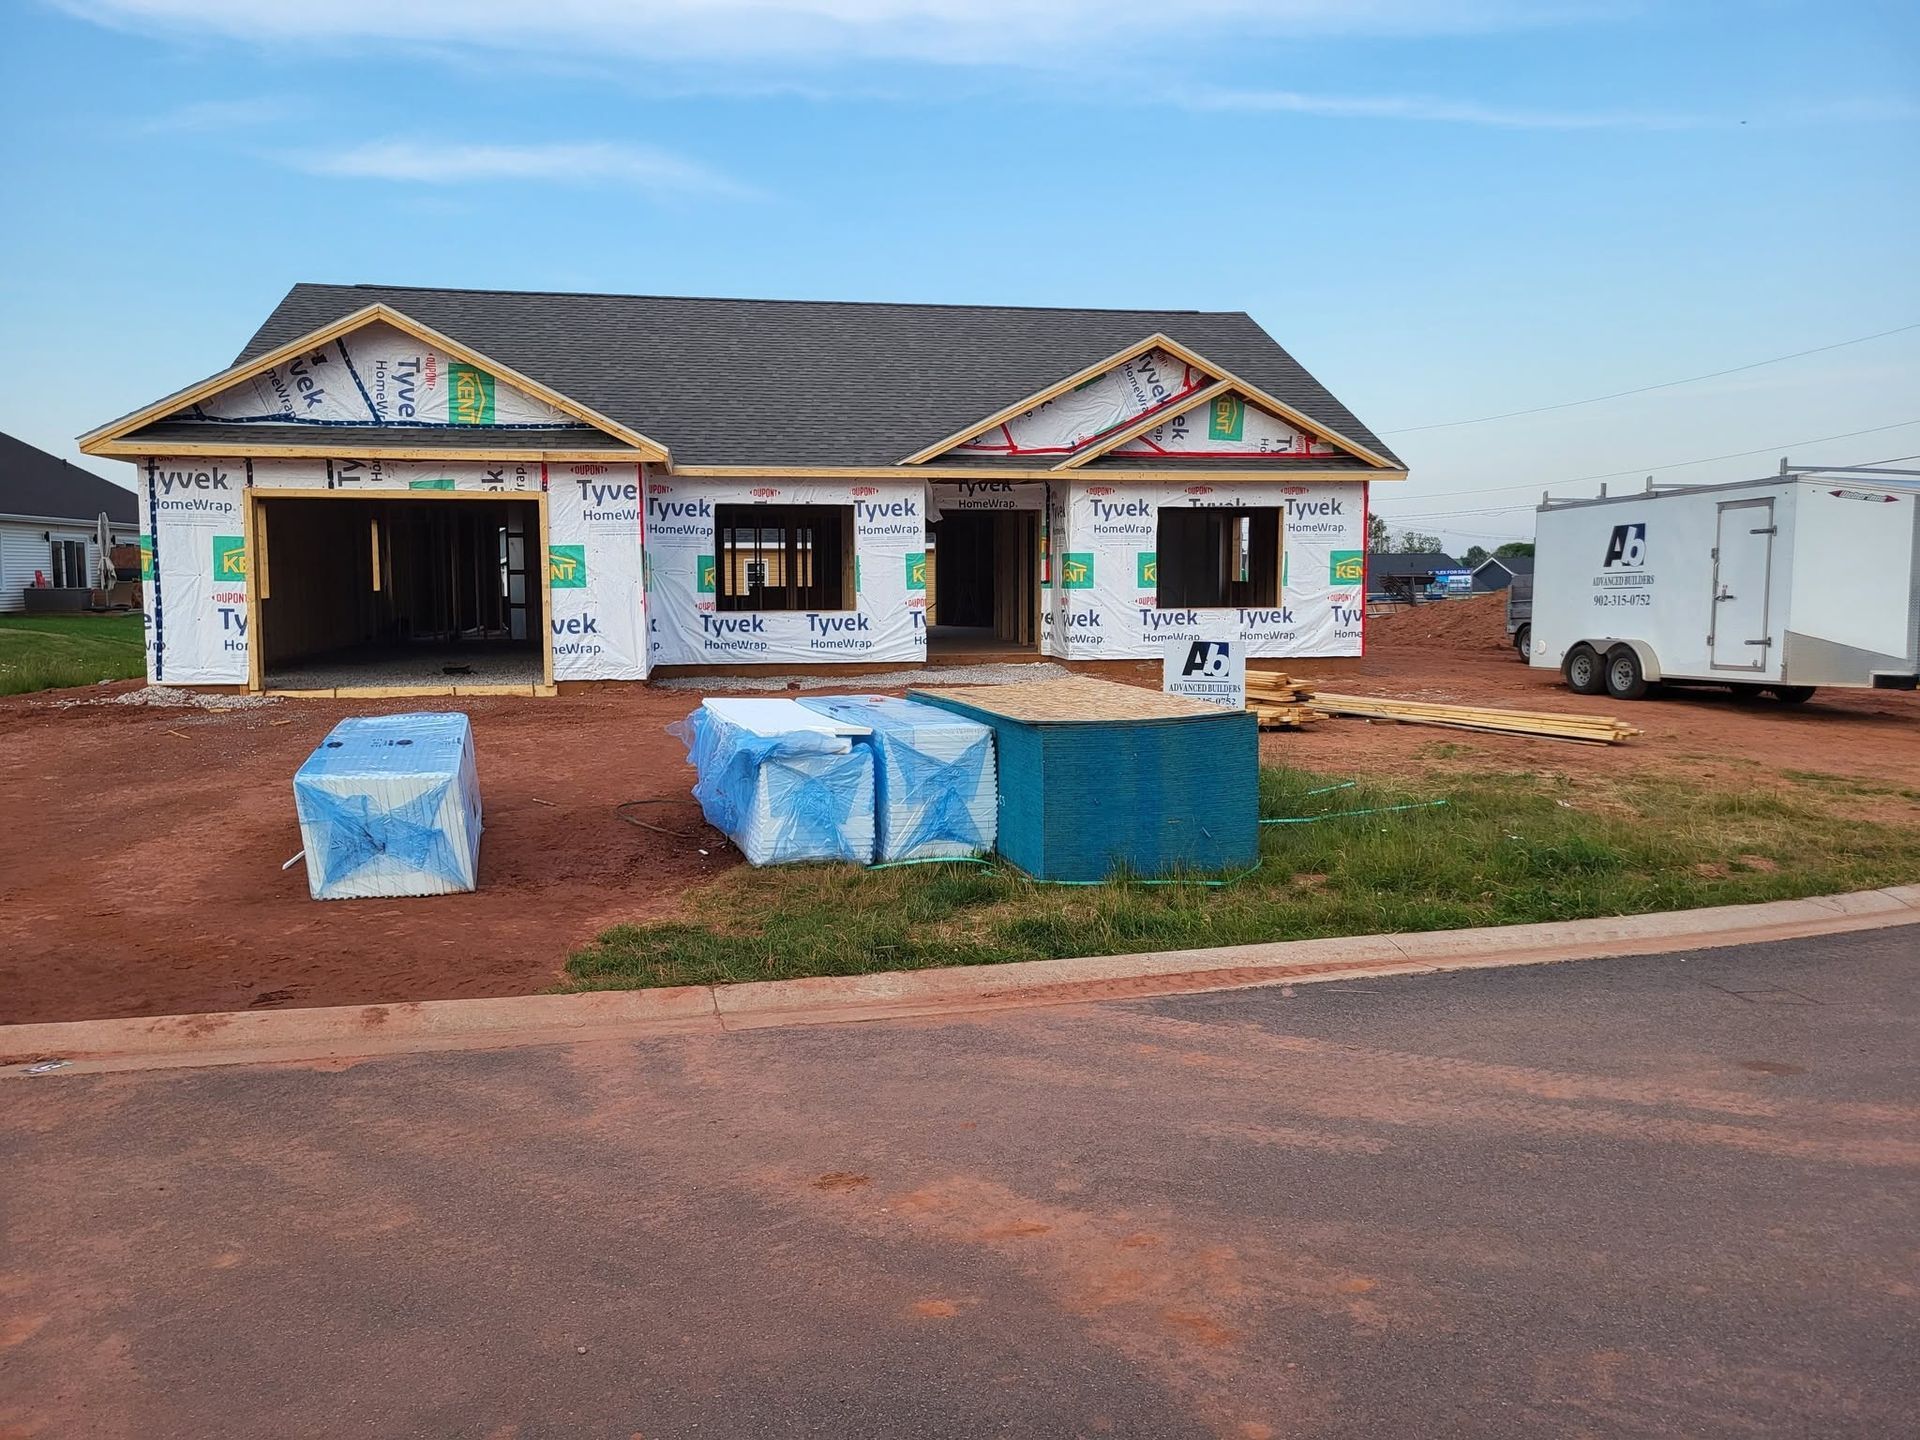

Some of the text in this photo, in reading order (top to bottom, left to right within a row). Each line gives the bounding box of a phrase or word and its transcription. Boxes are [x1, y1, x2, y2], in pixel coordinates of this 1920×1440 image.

[425, 357, 436, 387] DUPONT
[376, 360, 388, 420] HomeWr
[391, 357, 420, 418] Tyve
[457, 372, 476, 424] KENT
[574, 464, 604, 476] DUPONT
[576, 479, 637, 506] Tyve
[752, 488, 778, 498] DUPONT
[851, 487, 877, 497] DUPONT
[958, 480, 1013, 497] Tyvek
[1088, 488, 1113, 496] DUPONT
[1187, 486, 1210, 495] DUPONT
[1283, 486, 1308, 495] DUPONT
[648, 497, 711, 522] Tyvek
[958, 499, 1015, 509] HomeWrap
[1285, 498, 1342, 520] Tyvek
[583, 510, 640, 521] HomeWr
[854, 500, 917, 522] Tyvek
[1090, 499, 1150, 522] Tyvek
[649, 524, 714, 537] HomeWrap
[858, 524, 920, 536] HomeWrap
[1094, 524, 1152, 534] HomeWrap
[1288, 523, 1344, 533] HomeWrap
[1592, 574, 1655, 586] ADVANCED BUILDERS
[1330, 594, 1352, 602] DUPONT
[1593, 594, 1651, 606] 902-315-0752
[1140, 608, 1198, 630] Tyvek
[1236, 607, 1293, 628] Tyvek
[700, 614, 764, 636] Tyvek
[806, 613, 870, 636] Tyvek
[1142, 632, 1200, 642] HomeWrap
[1240, 632, 1296, 641] HomeWrap
[704, 638, 768, 650] HomeWrap
[810, 638, 873, 650] HomeWrap
[1168, 684, 1241, 693] ADVANCED BUILDERS
